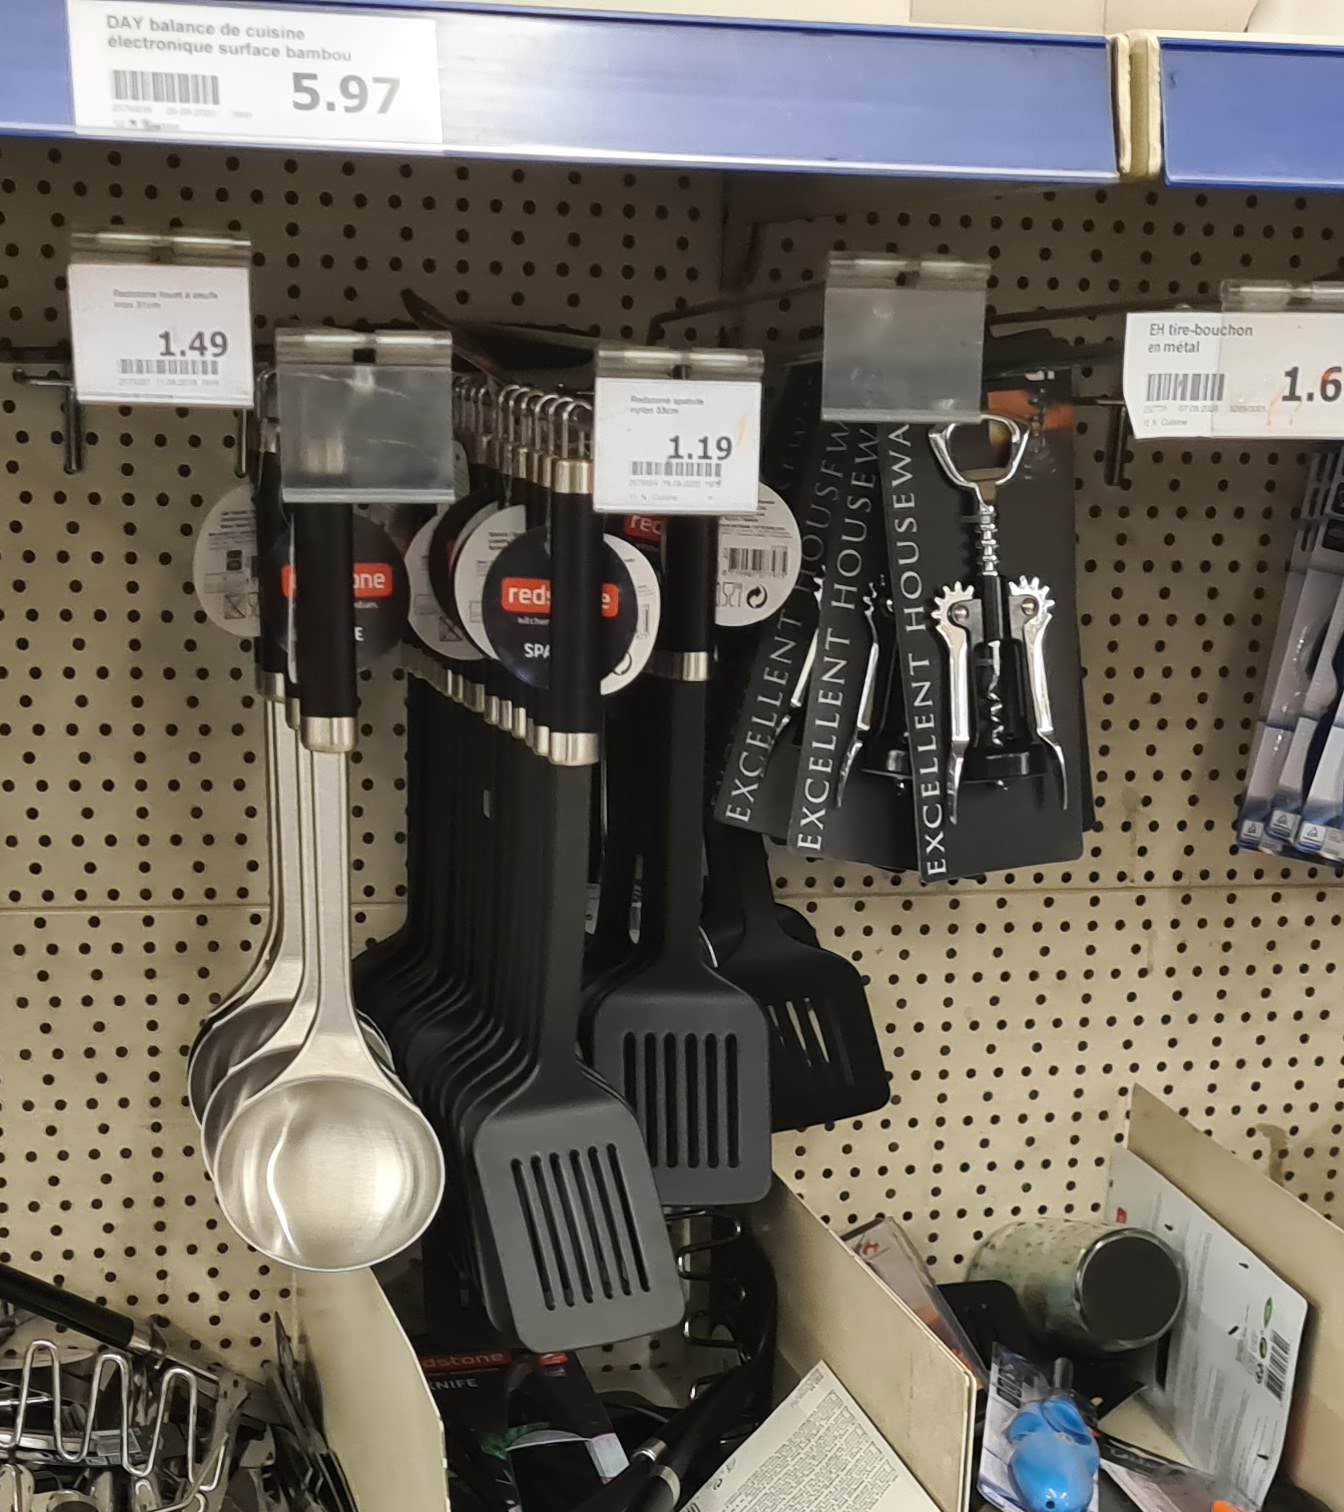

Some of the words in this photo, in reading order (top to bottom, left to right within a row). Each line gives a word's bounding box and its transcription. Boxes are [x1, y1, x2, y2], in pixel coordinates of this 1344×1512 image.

[106, 15, 143, 32] DAY
[149, 18, 215, 36] balance
[221, 22, 240, 37] de
[246, 25, 305, 41] cuisine
[107, 34, 213, 55] électronique
[218, 42, 281, 58] surface
[286, 45, 352, 63] bambou
[292, 71, 400, 115] 5.97
[158, 331, 228, 357] 1.49
[1149, 324, 1164, 336] EH
[1169, 324, 1253, 337] tire-bouchon
[1148, 343, 1160, 353] en
[1163, 341, 1199, 353] métal
[668, 435, 732, 461] 1.19
[887, 424, 927, 632] HOUSEWA
[726, 615, 802, 825] EXCELLENT
[798, 629, 850, 852] EXCELLENT
[909, 653, 947, 876] EXCELLENT
[424, 1351, 506, 1368] dstone
